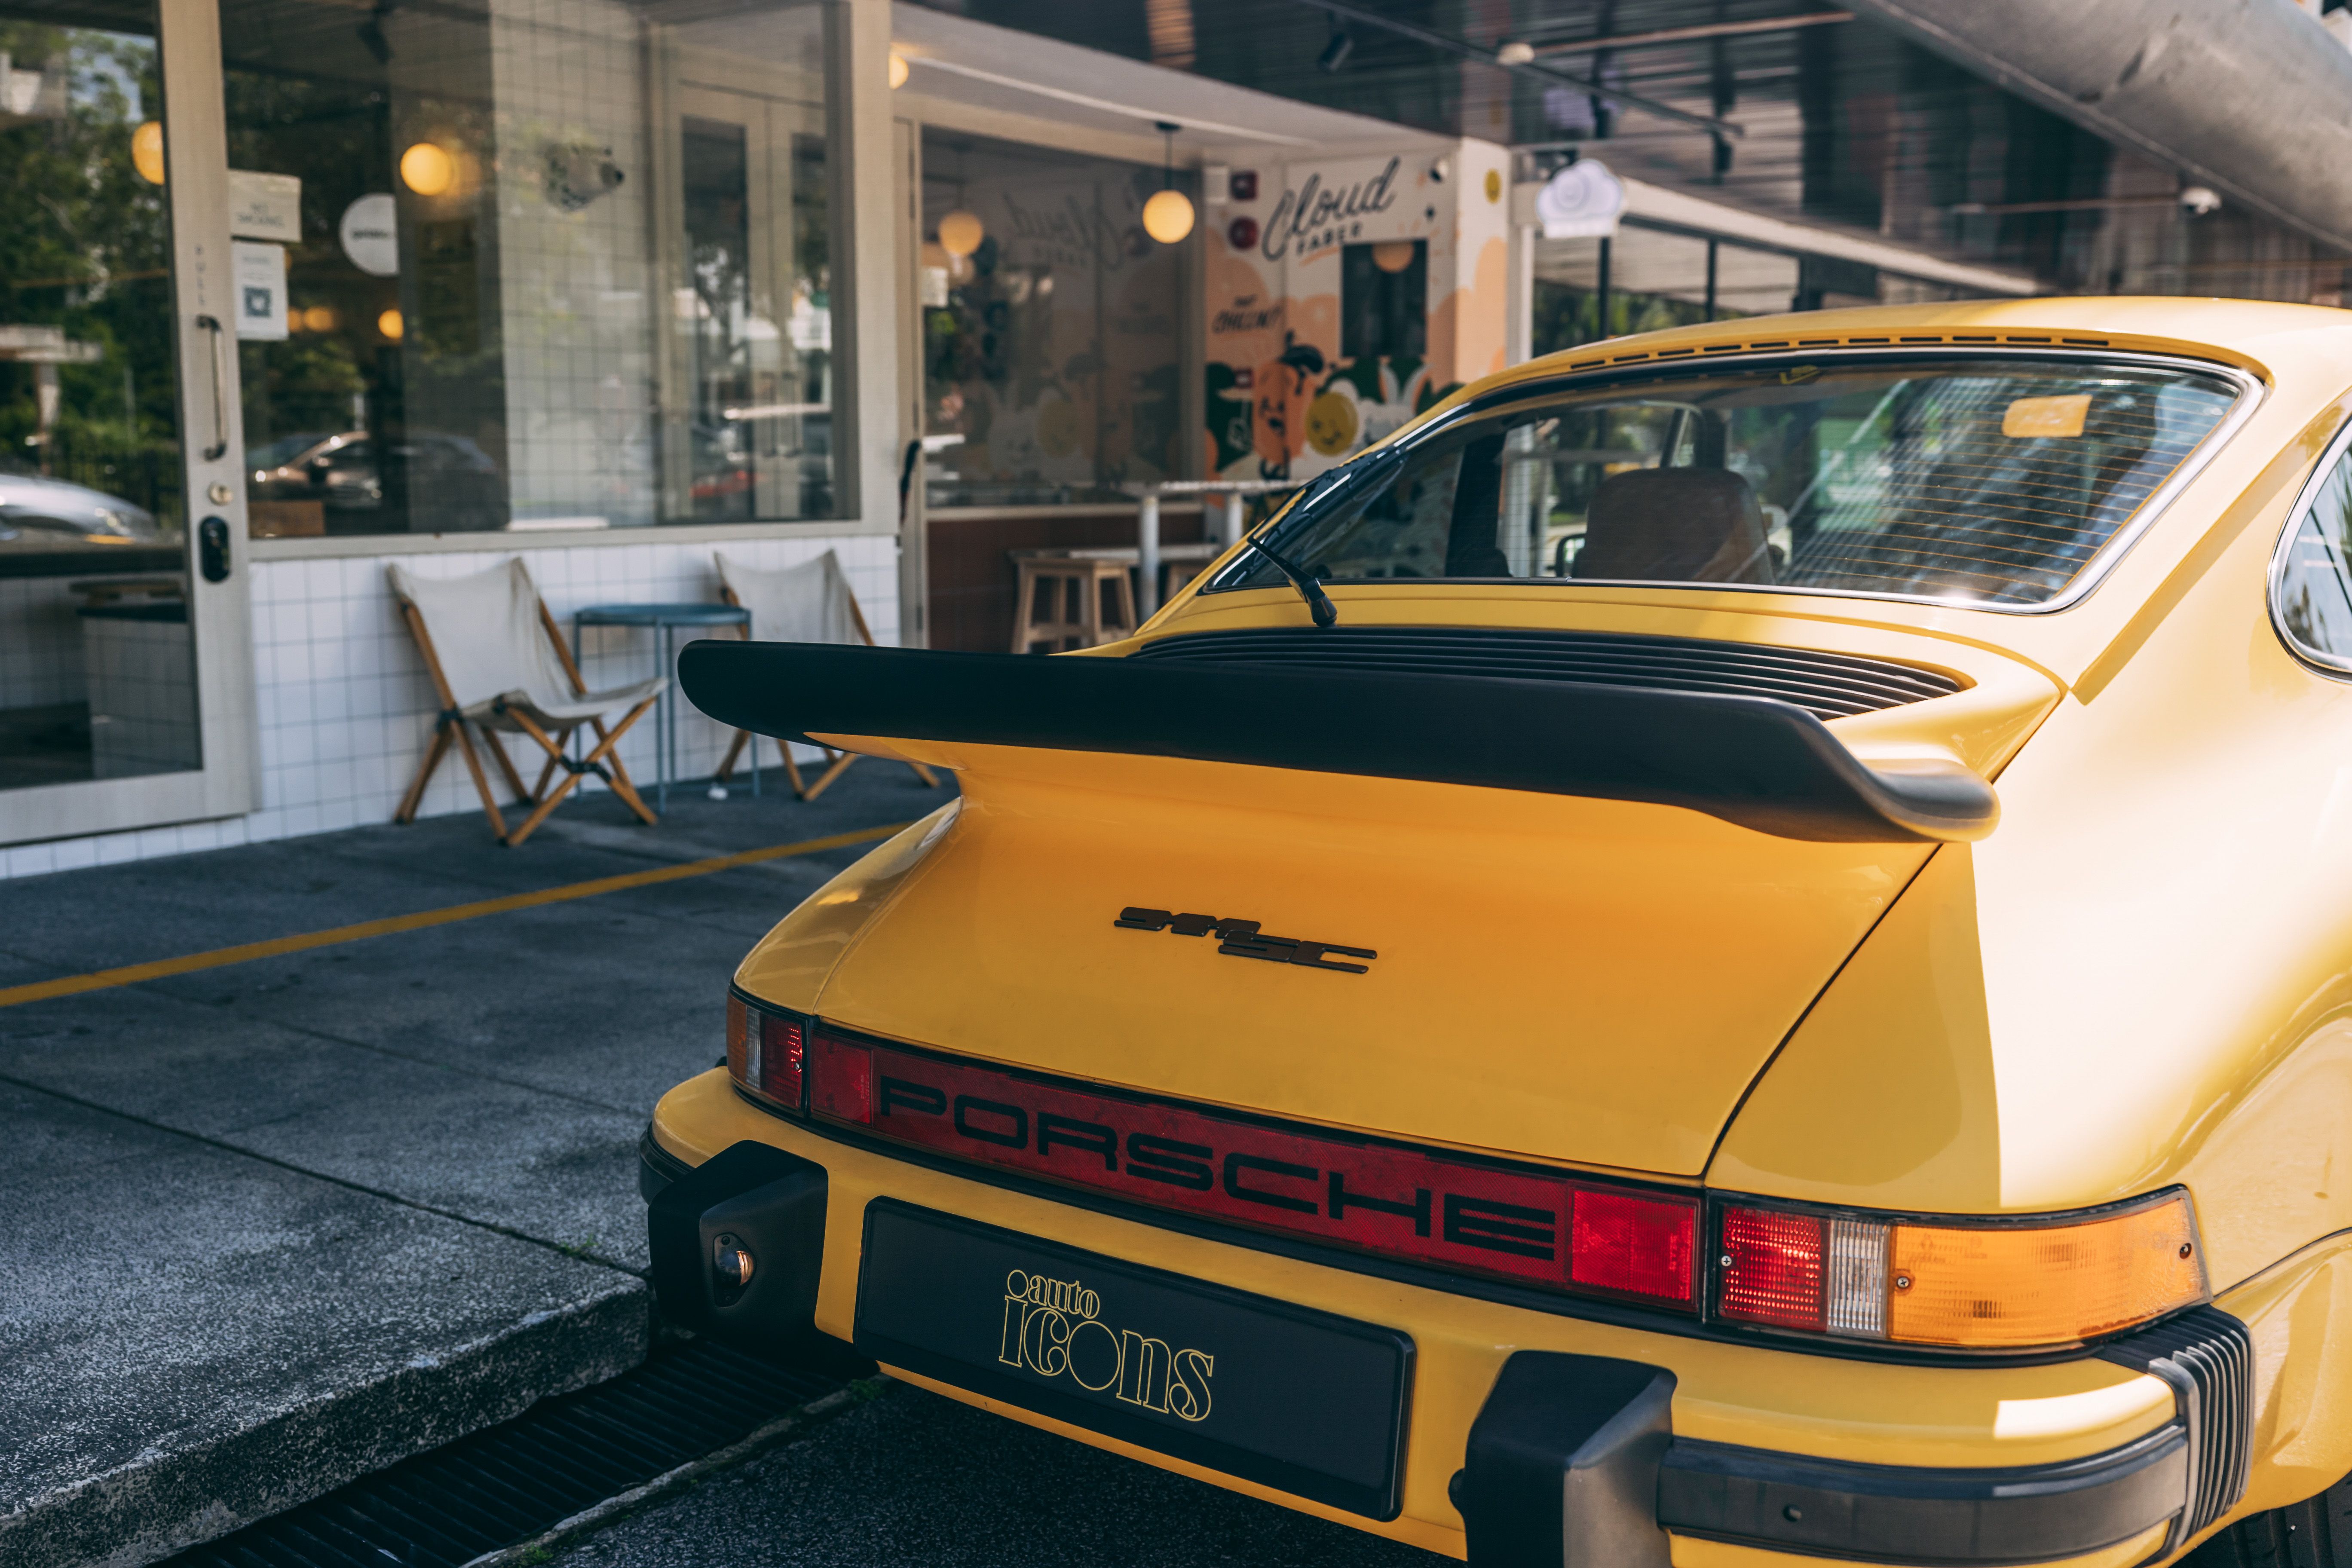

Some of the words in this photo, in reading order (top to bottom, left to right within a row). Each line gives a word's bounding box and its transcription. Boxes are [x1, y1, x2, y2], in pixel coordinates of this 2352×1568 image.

[1262, 155, 1400, 261] Cloud
[882, 1076, 1555, 1260] PORSCHE
[1027, 1274, 1100, 1319] auto
